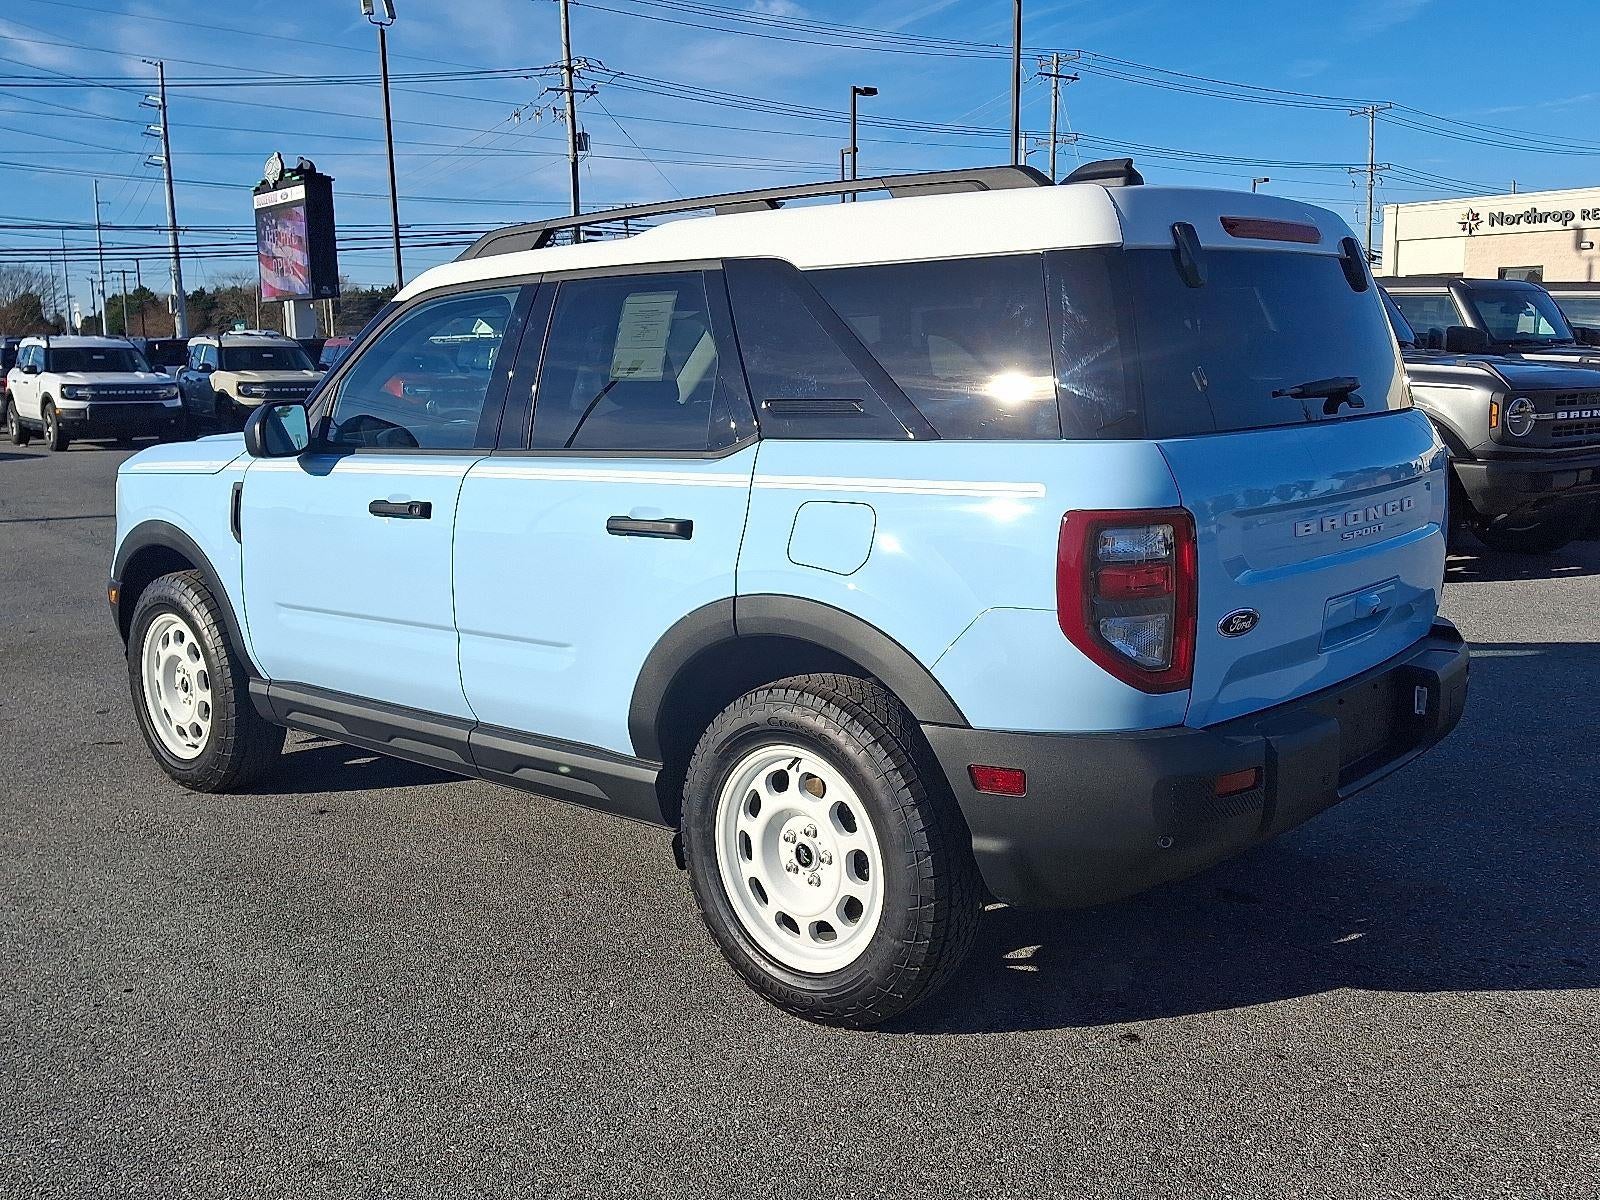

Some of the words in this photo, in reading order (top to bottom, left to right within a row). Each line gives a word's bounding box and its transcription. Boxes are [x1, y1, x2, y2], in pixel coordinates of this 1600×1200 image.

[1489, 207, 1575, 227] Northrop
[1580, 207, 1600, 221] RE
[1295, 496, 1415, 537] BRONCO
[1341, 523, 1384, 541] SPORT
[1229, 615, 1253, 633] Ford
